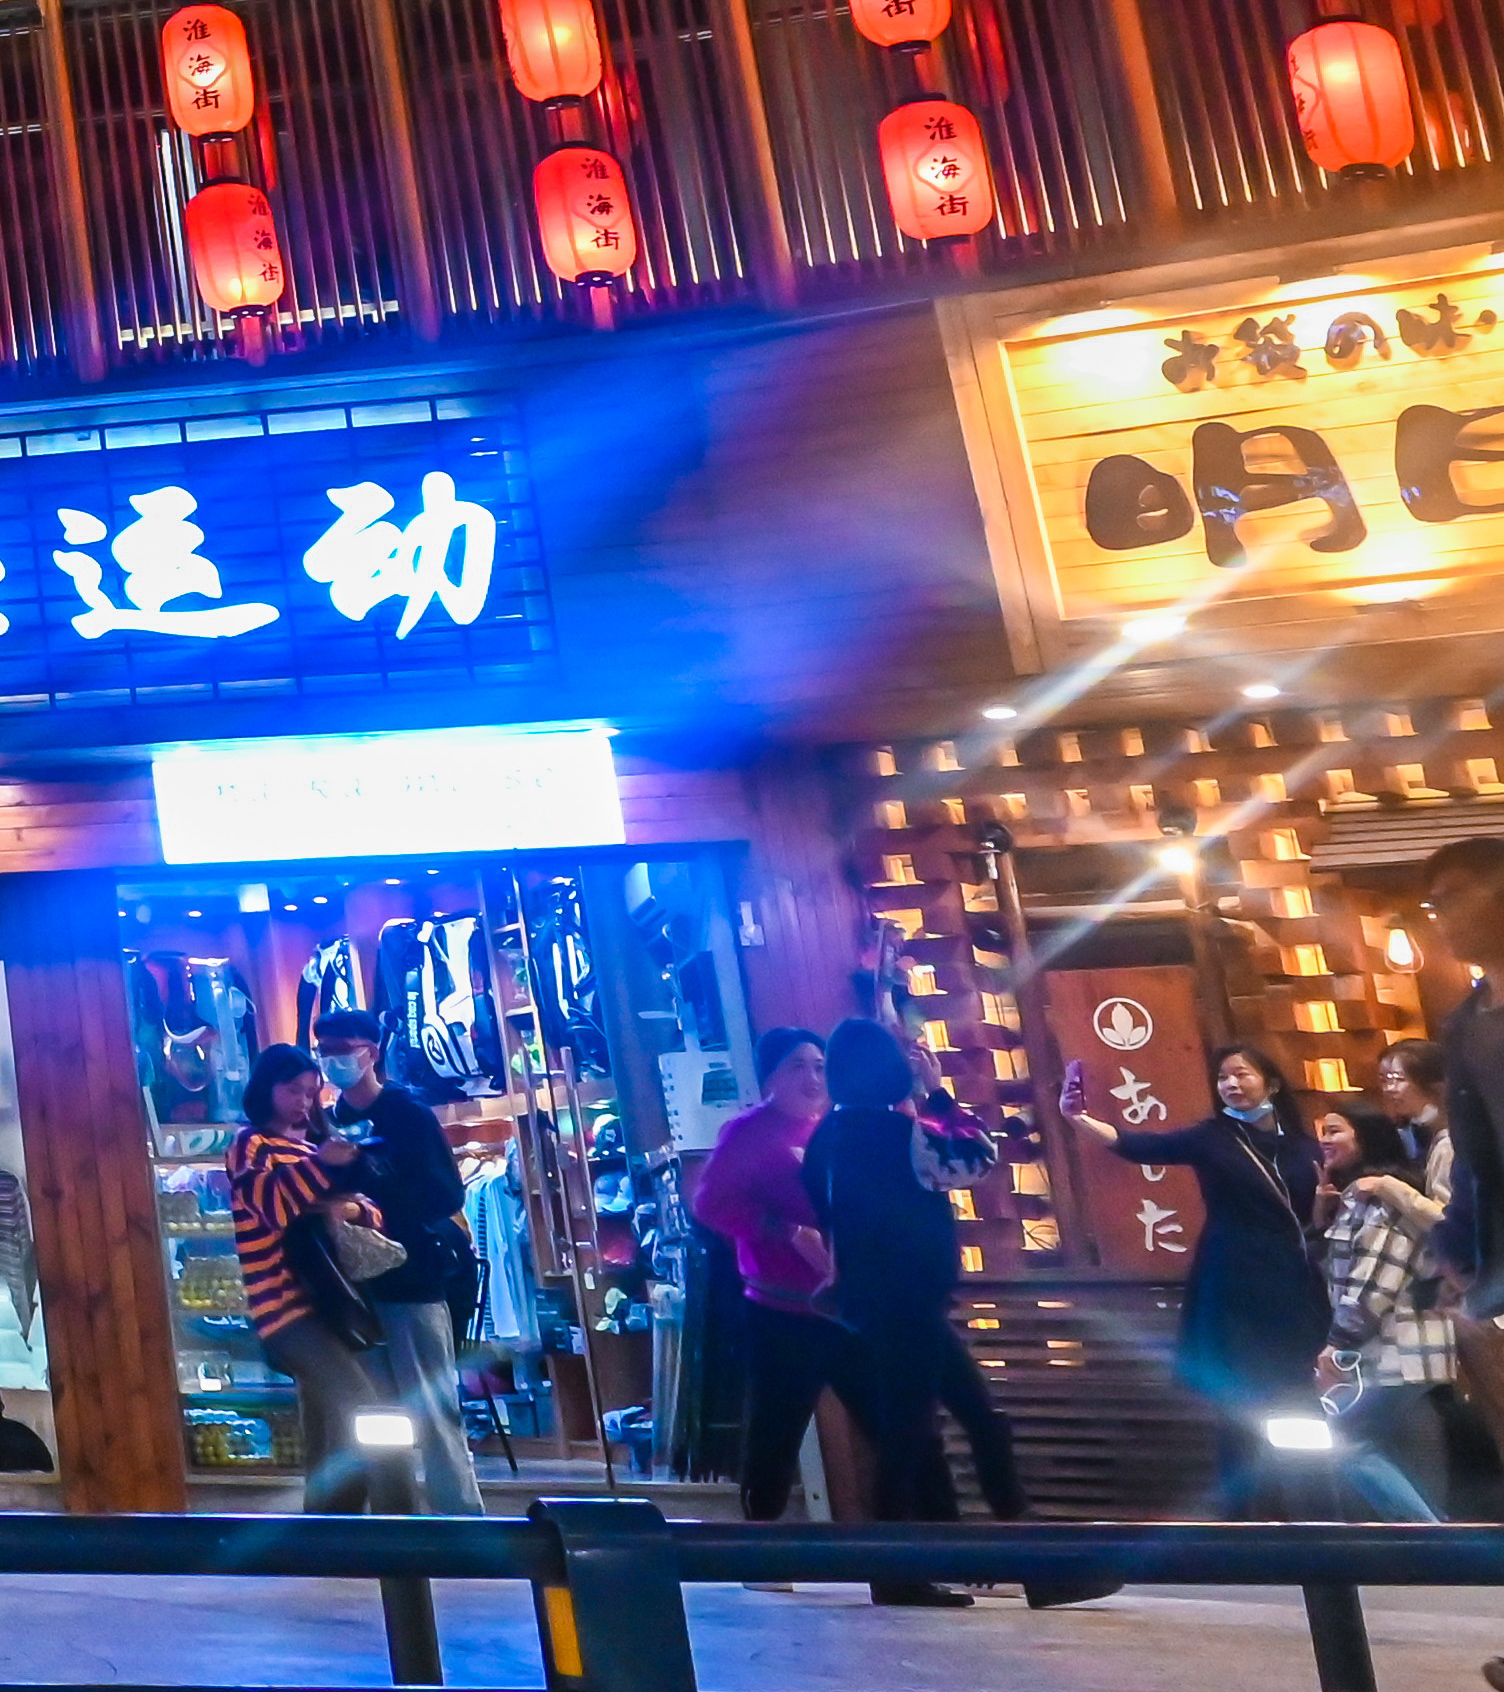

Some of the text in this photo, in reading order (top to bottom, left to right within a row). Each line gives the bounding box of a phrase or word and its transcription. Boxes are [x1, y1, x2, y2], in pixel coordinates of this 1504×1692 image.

[183, 18, 220, 109] 淮海街
[580, 157, 621, 250] 淮海街
[924, 117, 970, 216] 淮海街
